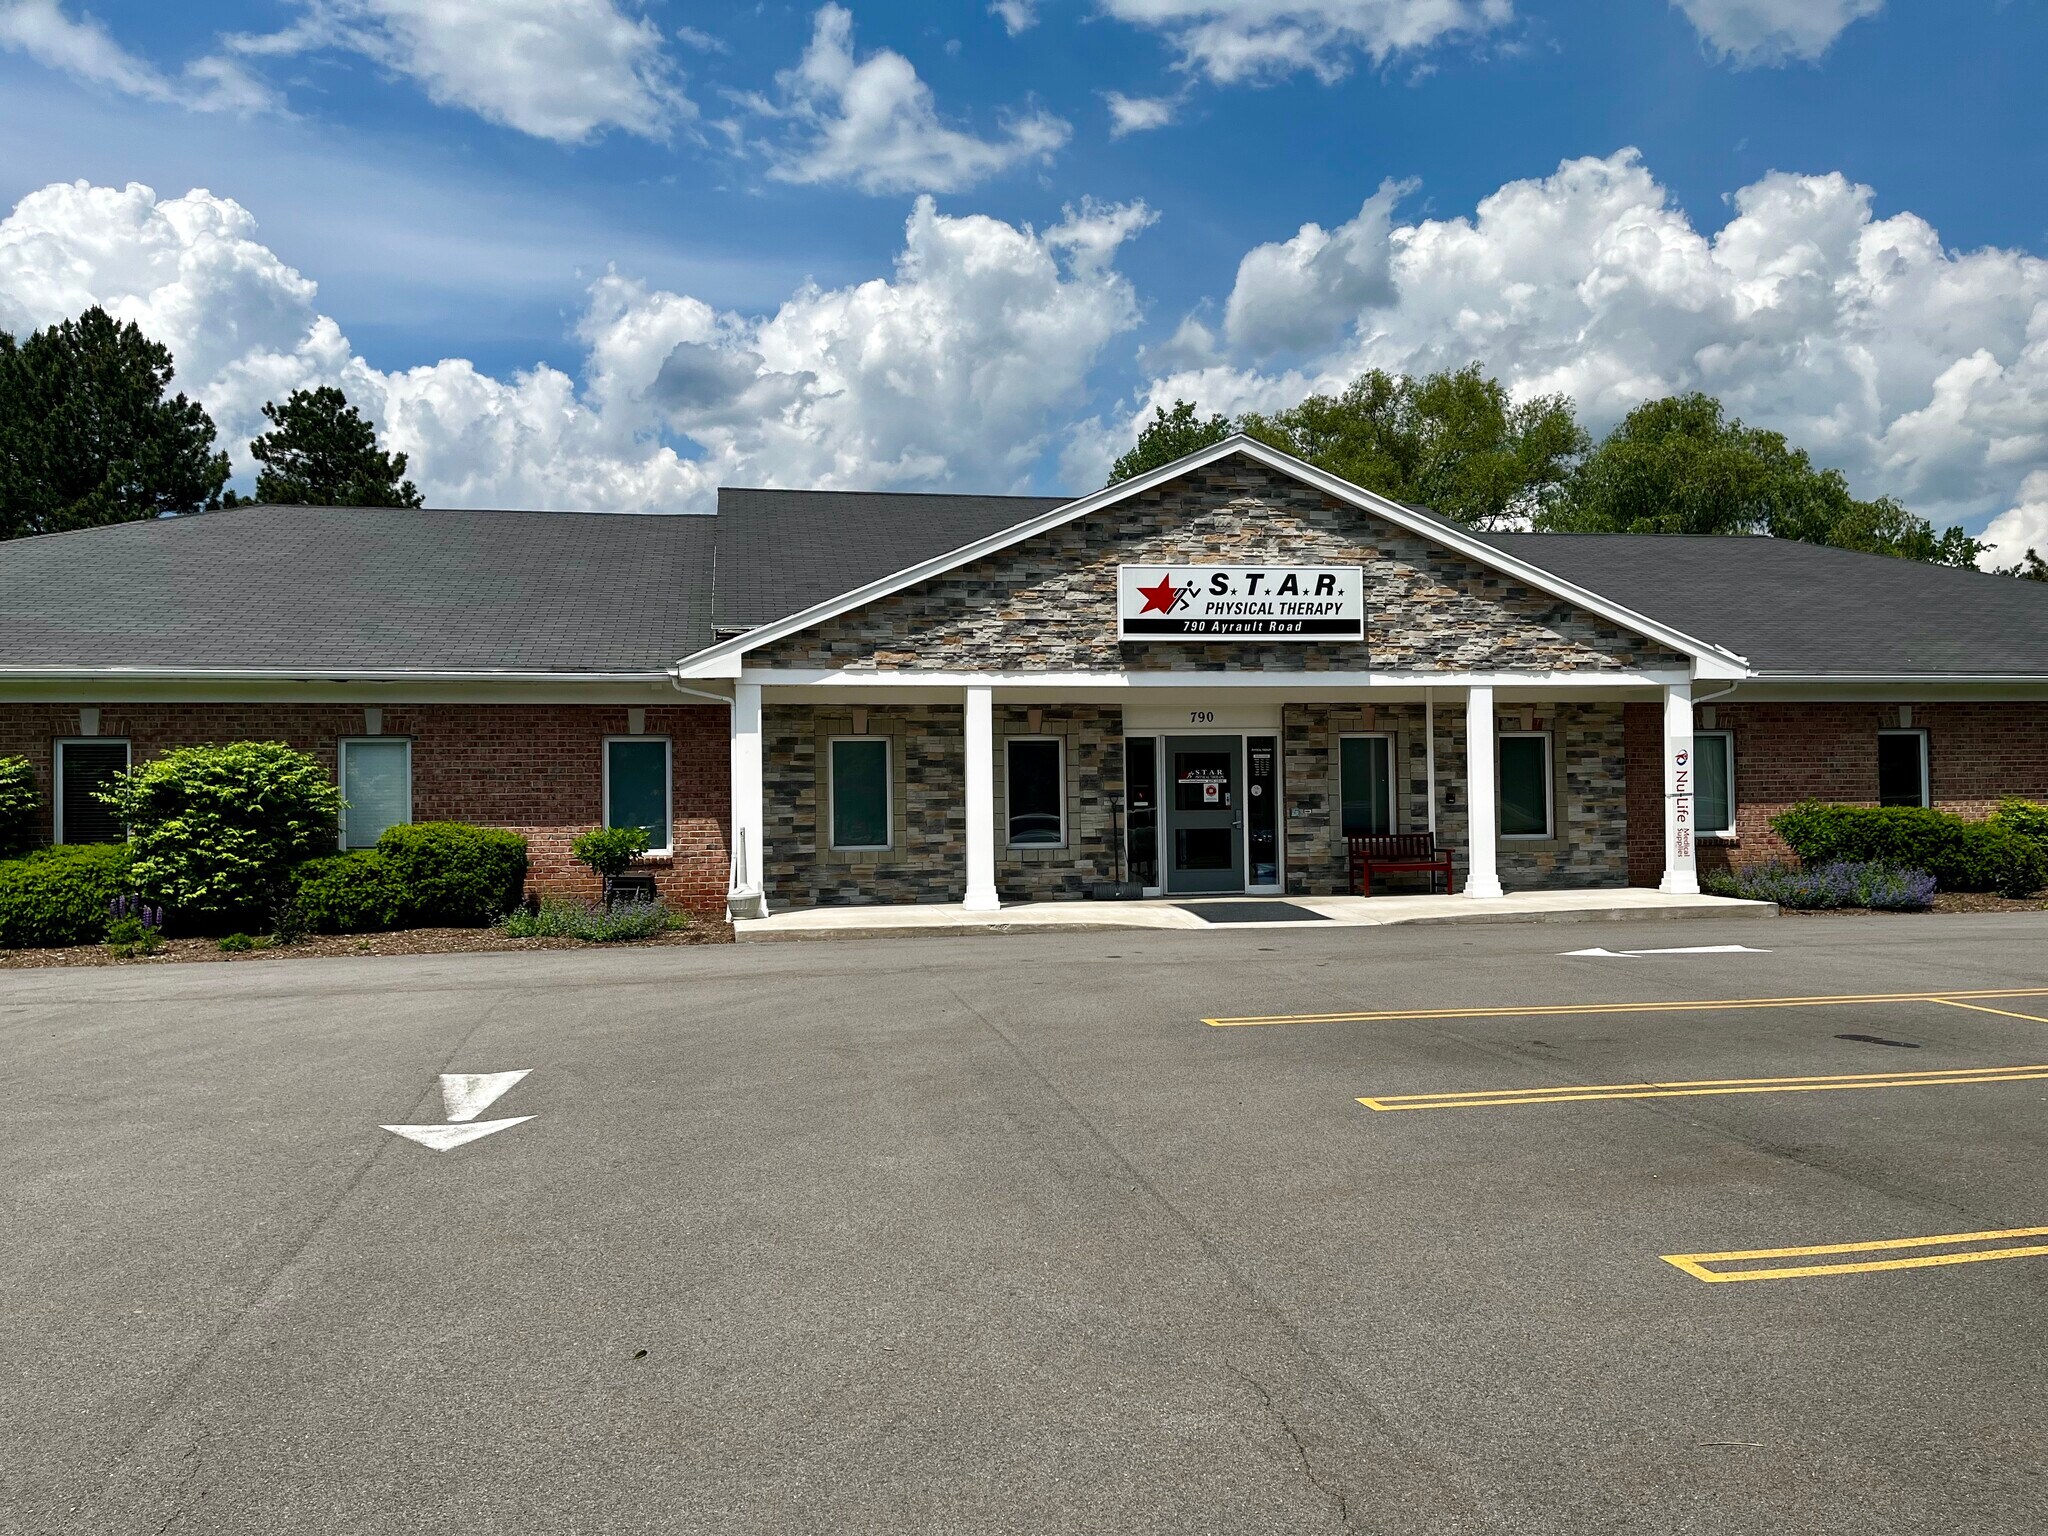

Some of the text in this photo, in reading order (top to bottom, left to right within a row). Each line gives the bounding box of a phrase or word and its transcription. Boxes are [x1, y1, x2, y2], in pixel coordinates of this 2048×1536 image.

[1205, 601, 1343, 616] PHYSICAL THERAPY
[1183, 621, 1303, 634] 790 Ayrault Road
[1190, 711, 1214, 723] 790
